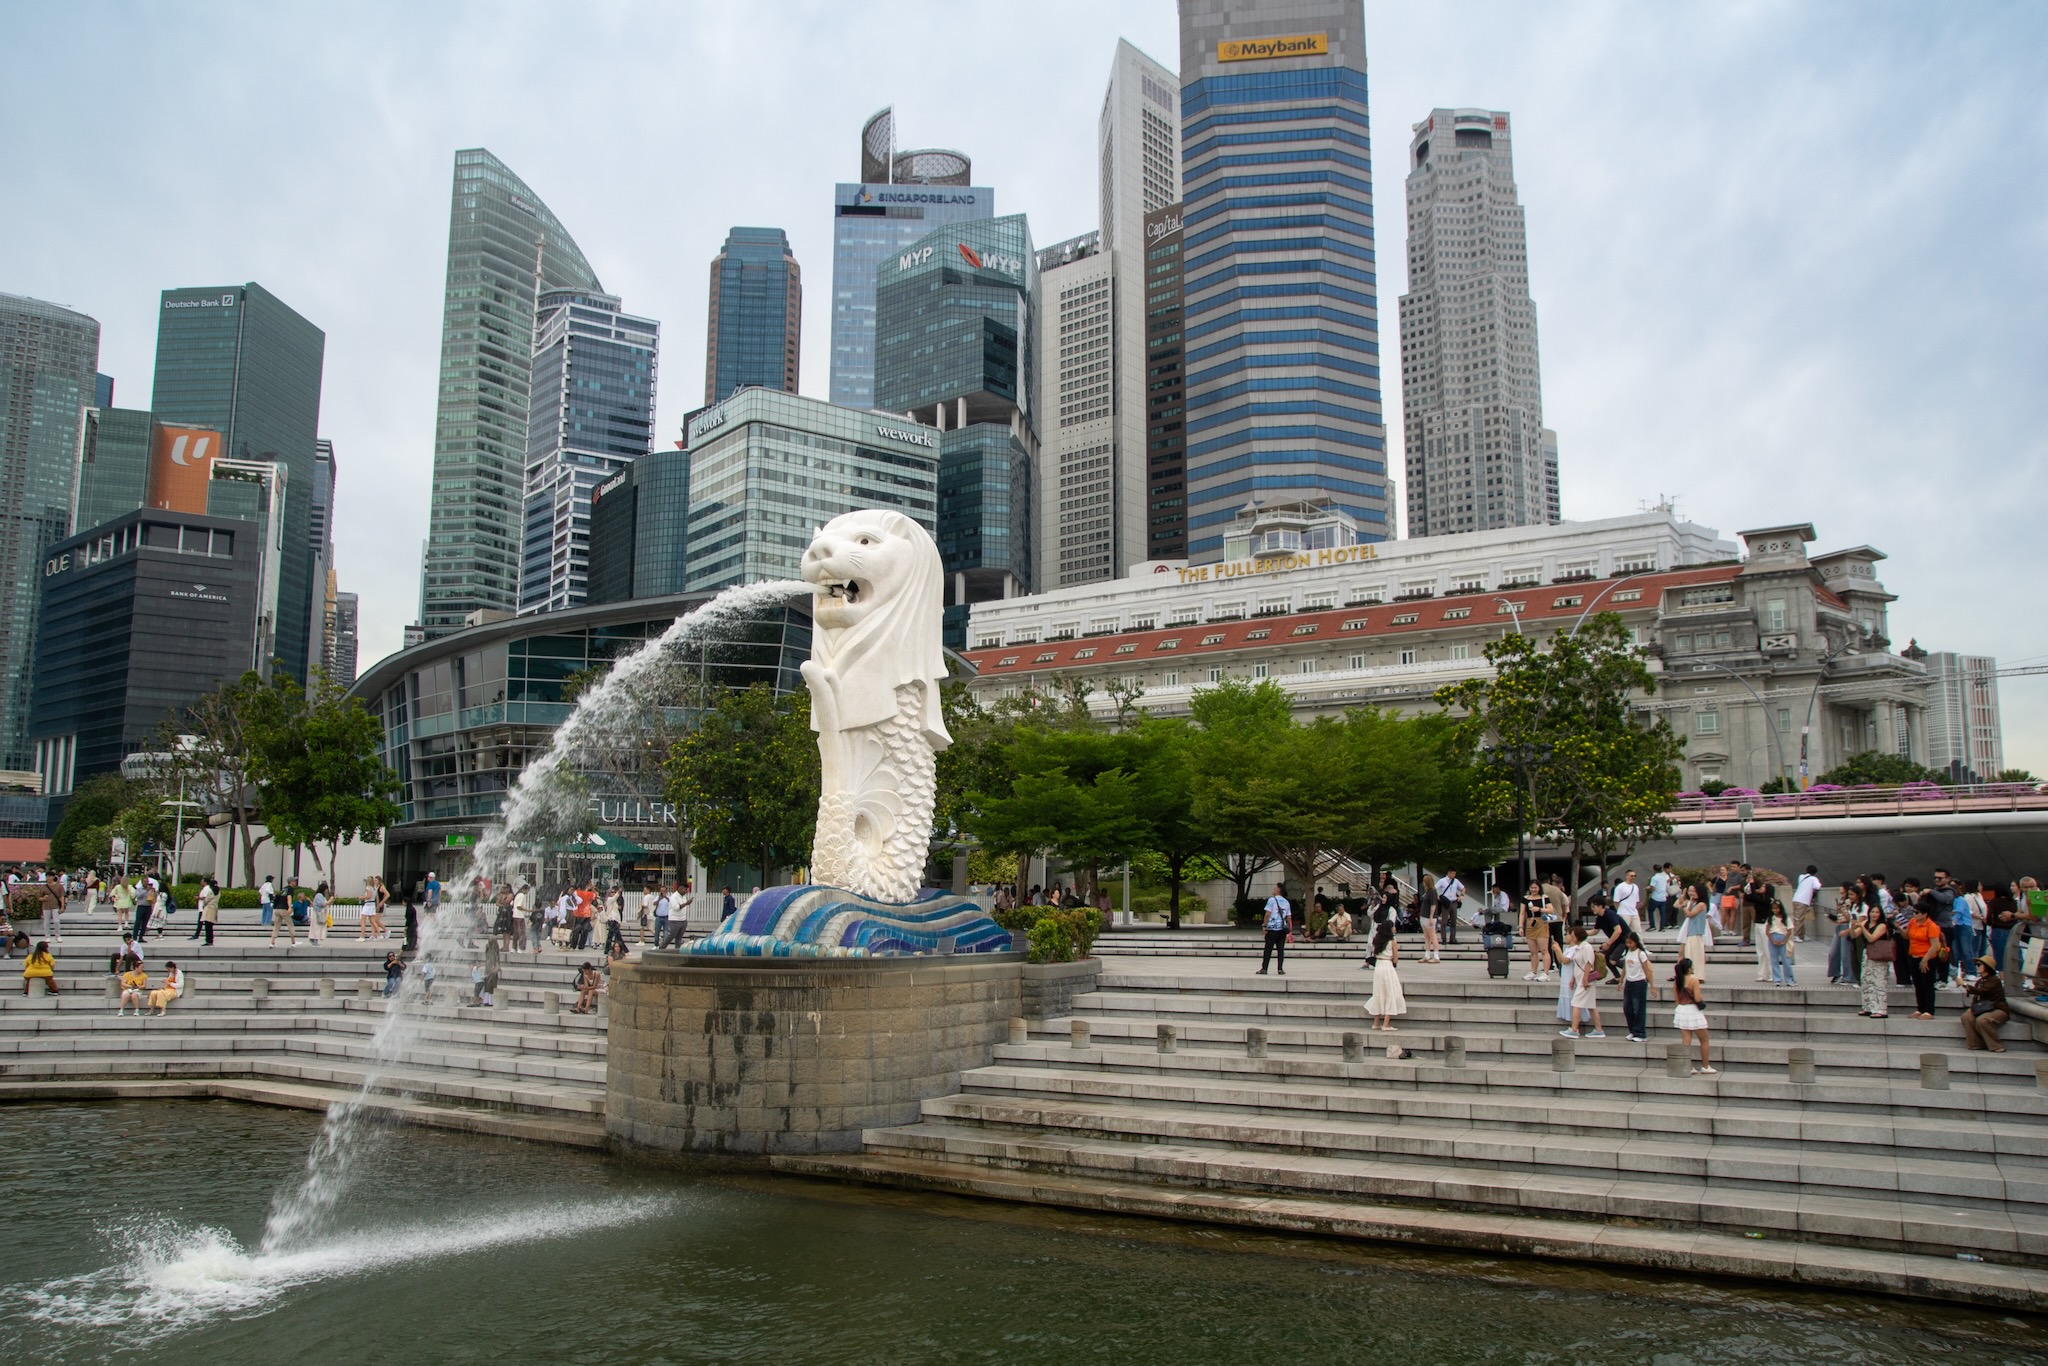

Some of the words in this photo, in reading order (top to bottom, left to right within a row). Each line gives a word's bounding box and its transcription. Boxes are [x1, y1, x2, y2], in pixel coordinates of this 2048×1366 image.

[1241, 37, 1317, 56] Maybank
[878, 193, 976, 205] SINGAPORELAND
[900, 246, 933, 272] MYP
[982, 252, 1021, 274] MYP
[165, 301, 200, 309] Deutsche
[200, 299, 225, 307] Bank
[877, 425, 933, 447] wework
[46, 553, 70, 577] OUE
[1178, 567, 1208, 583] THE
[1214, 553, 1311, 579] FULLERTON
[1318, 544, 1379, 565] HOTEL
